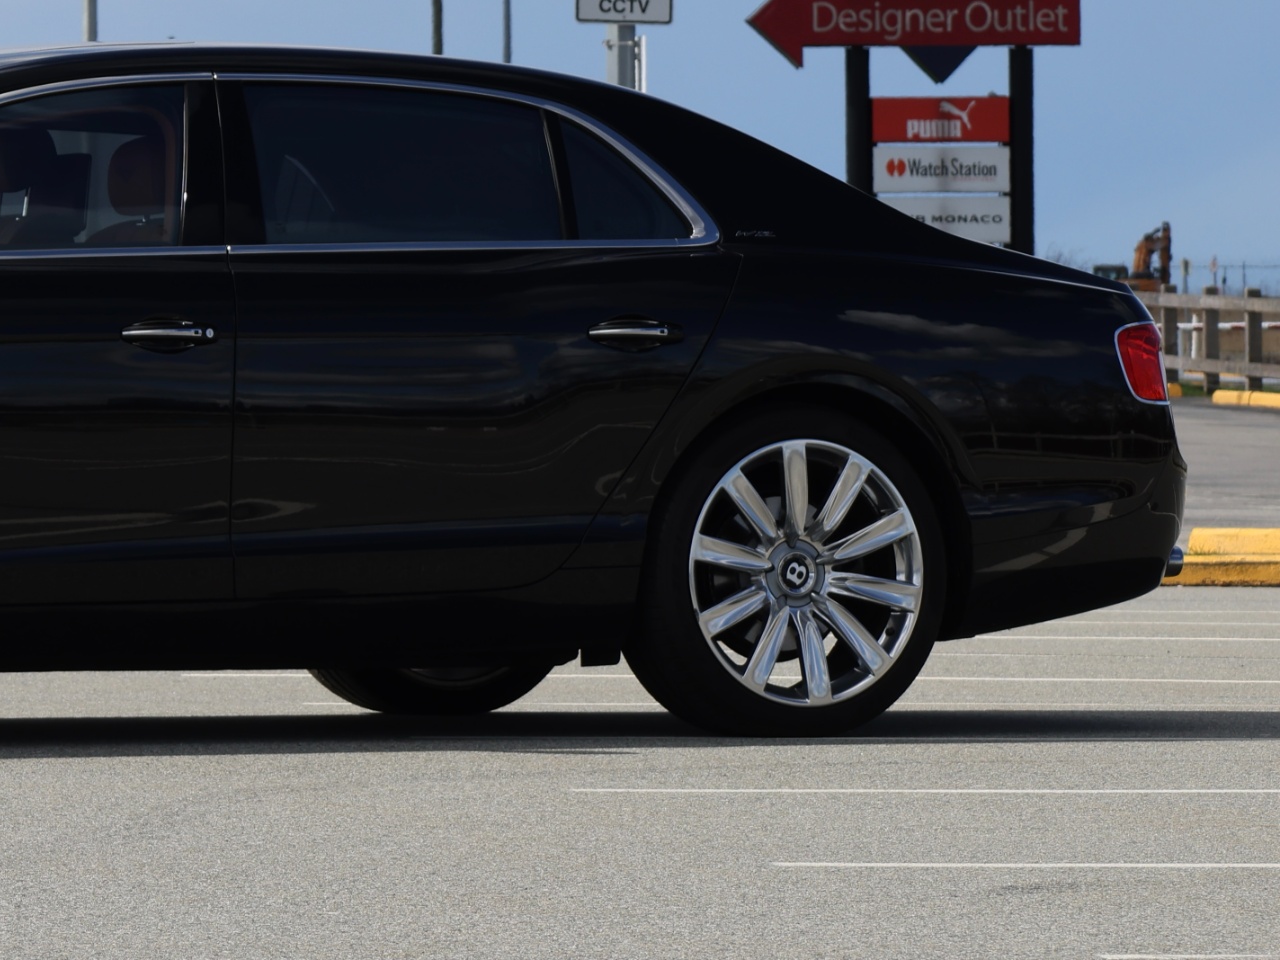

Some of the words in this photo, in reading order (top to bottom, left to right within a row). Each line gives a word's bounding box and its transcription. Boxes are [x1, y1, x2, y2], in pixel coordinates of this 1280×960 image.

[812, 1, 958, 40] Designer
[965, 0, 1069, 33] Outlet
[906, 119, 962, 139] PUMA
[907, 158, 948, 177] Watch
[951, 157, 997, 177] Station
[931, 214, 1003, 224] MONACO
